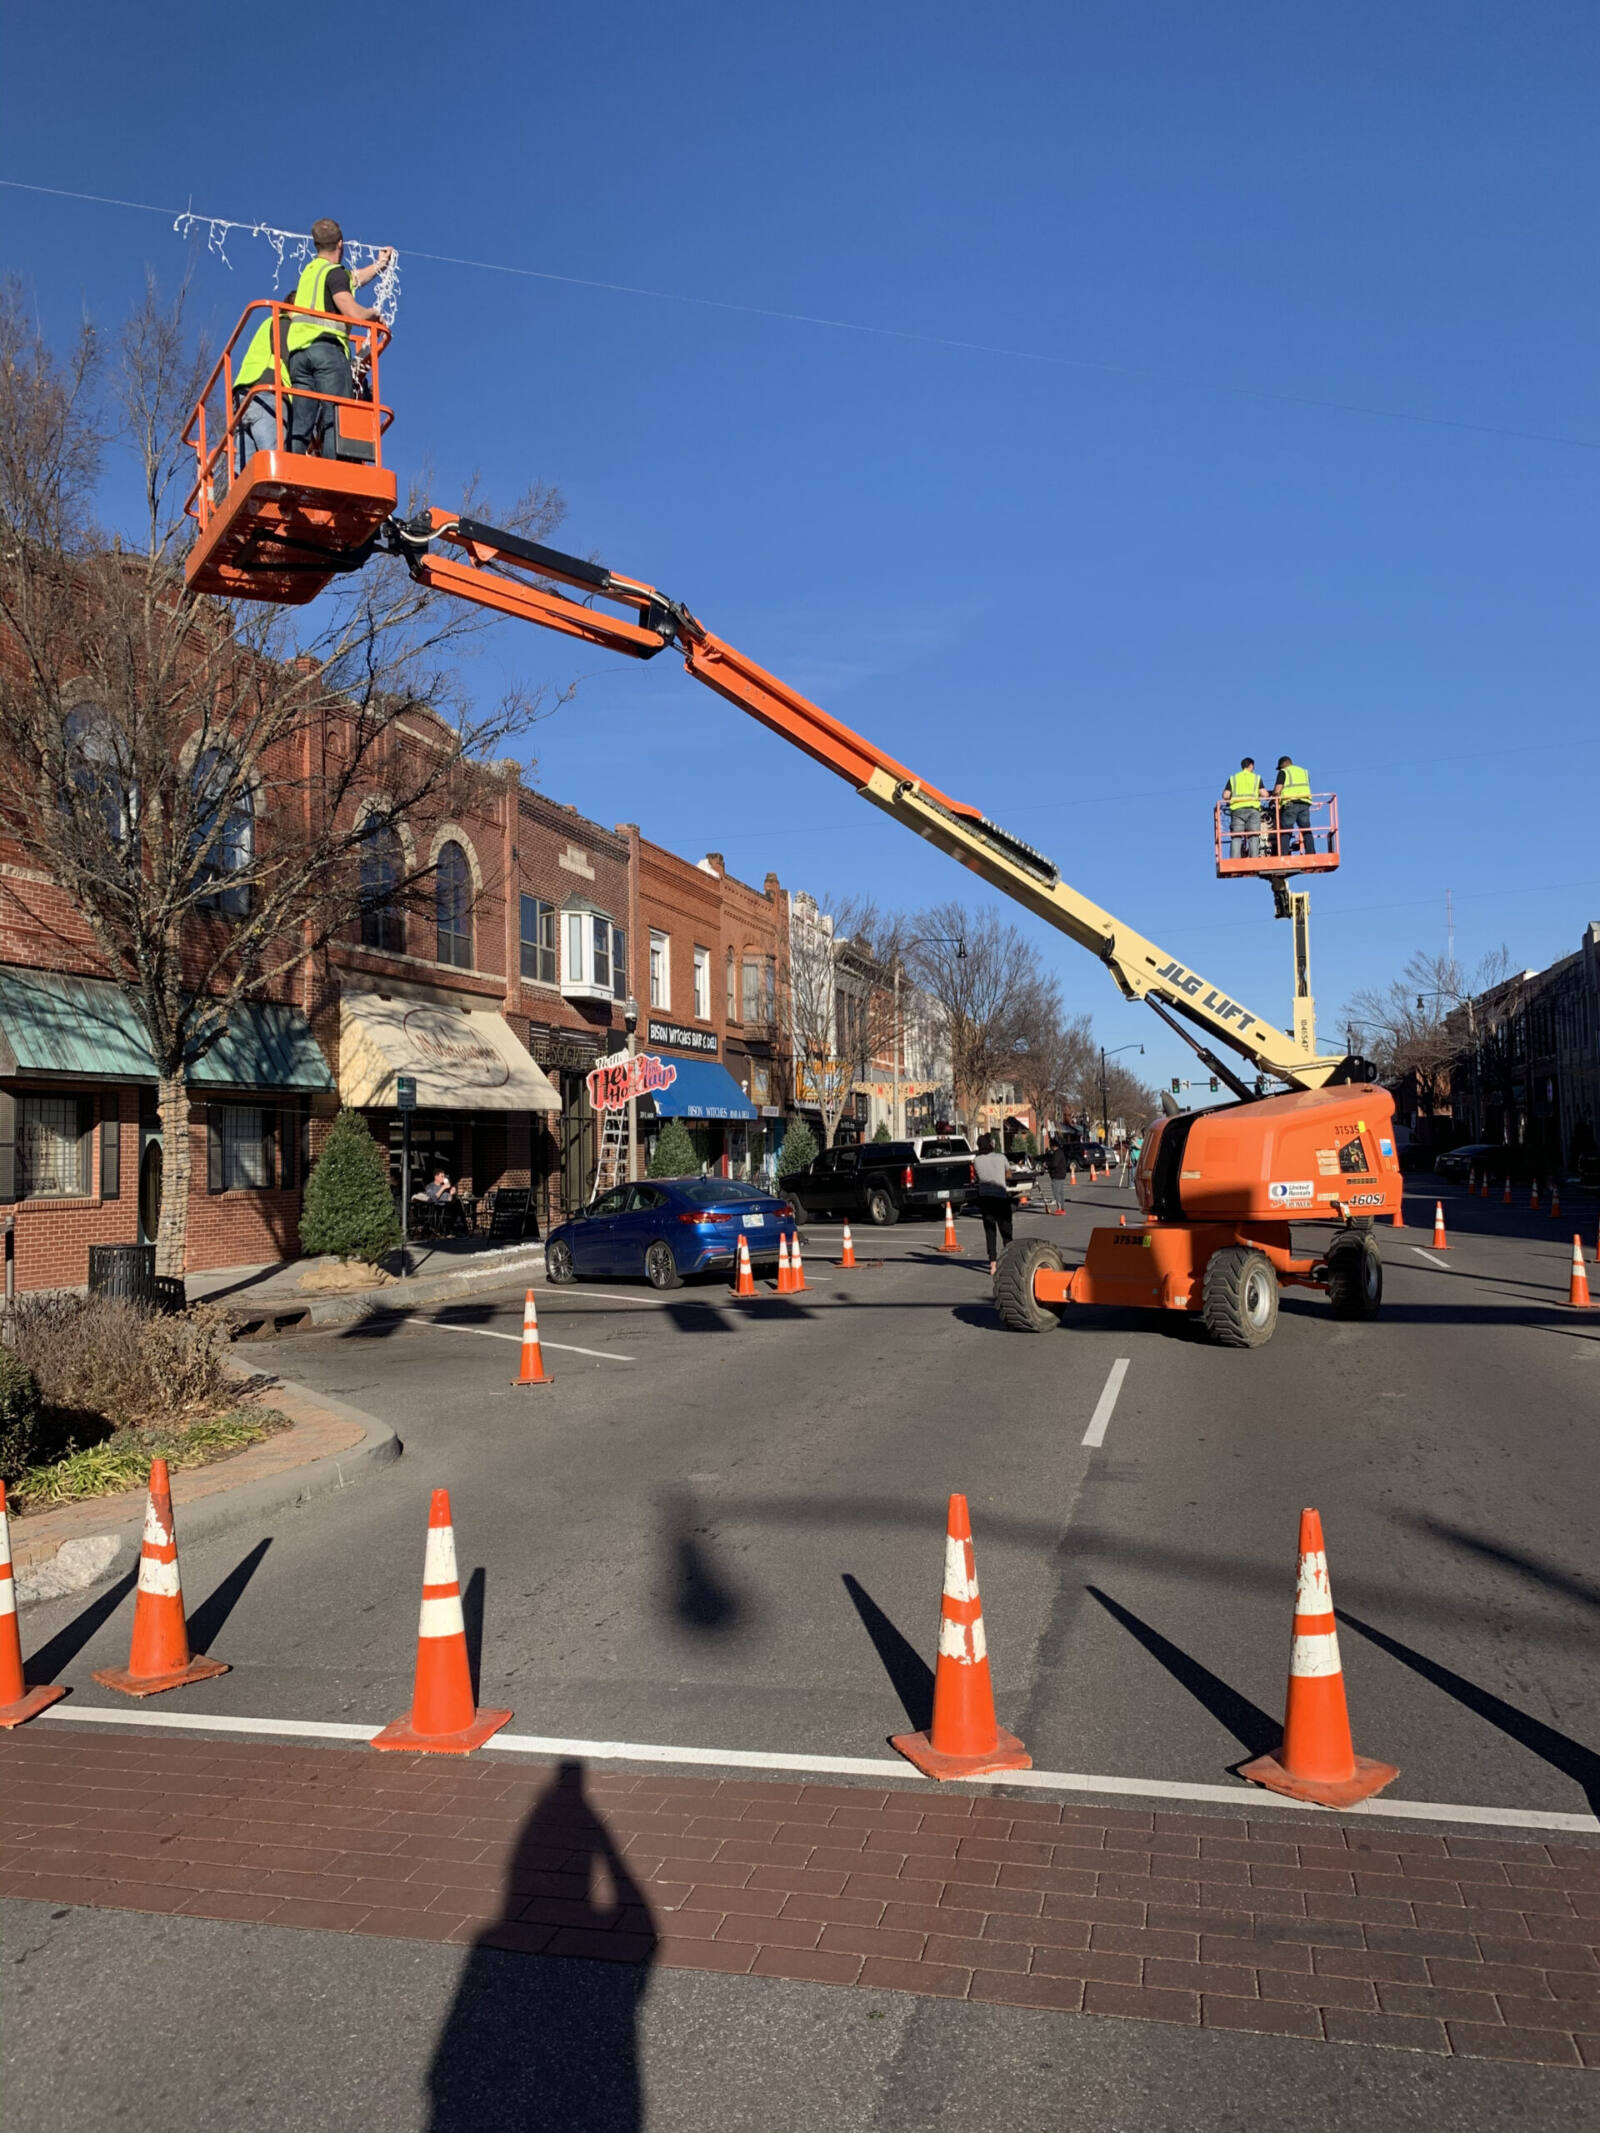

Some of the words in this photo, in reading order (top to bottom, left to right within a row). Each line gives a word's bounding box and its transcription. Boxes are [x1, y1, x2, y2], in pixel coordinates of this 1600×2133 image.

[1156, 962, 1204, 996] JLG
[1202, 990, 1256, 1031] LIFT
[650, 1024, 668, 1042] BISON
[669, 1026, 691, 1046] WITCHES
